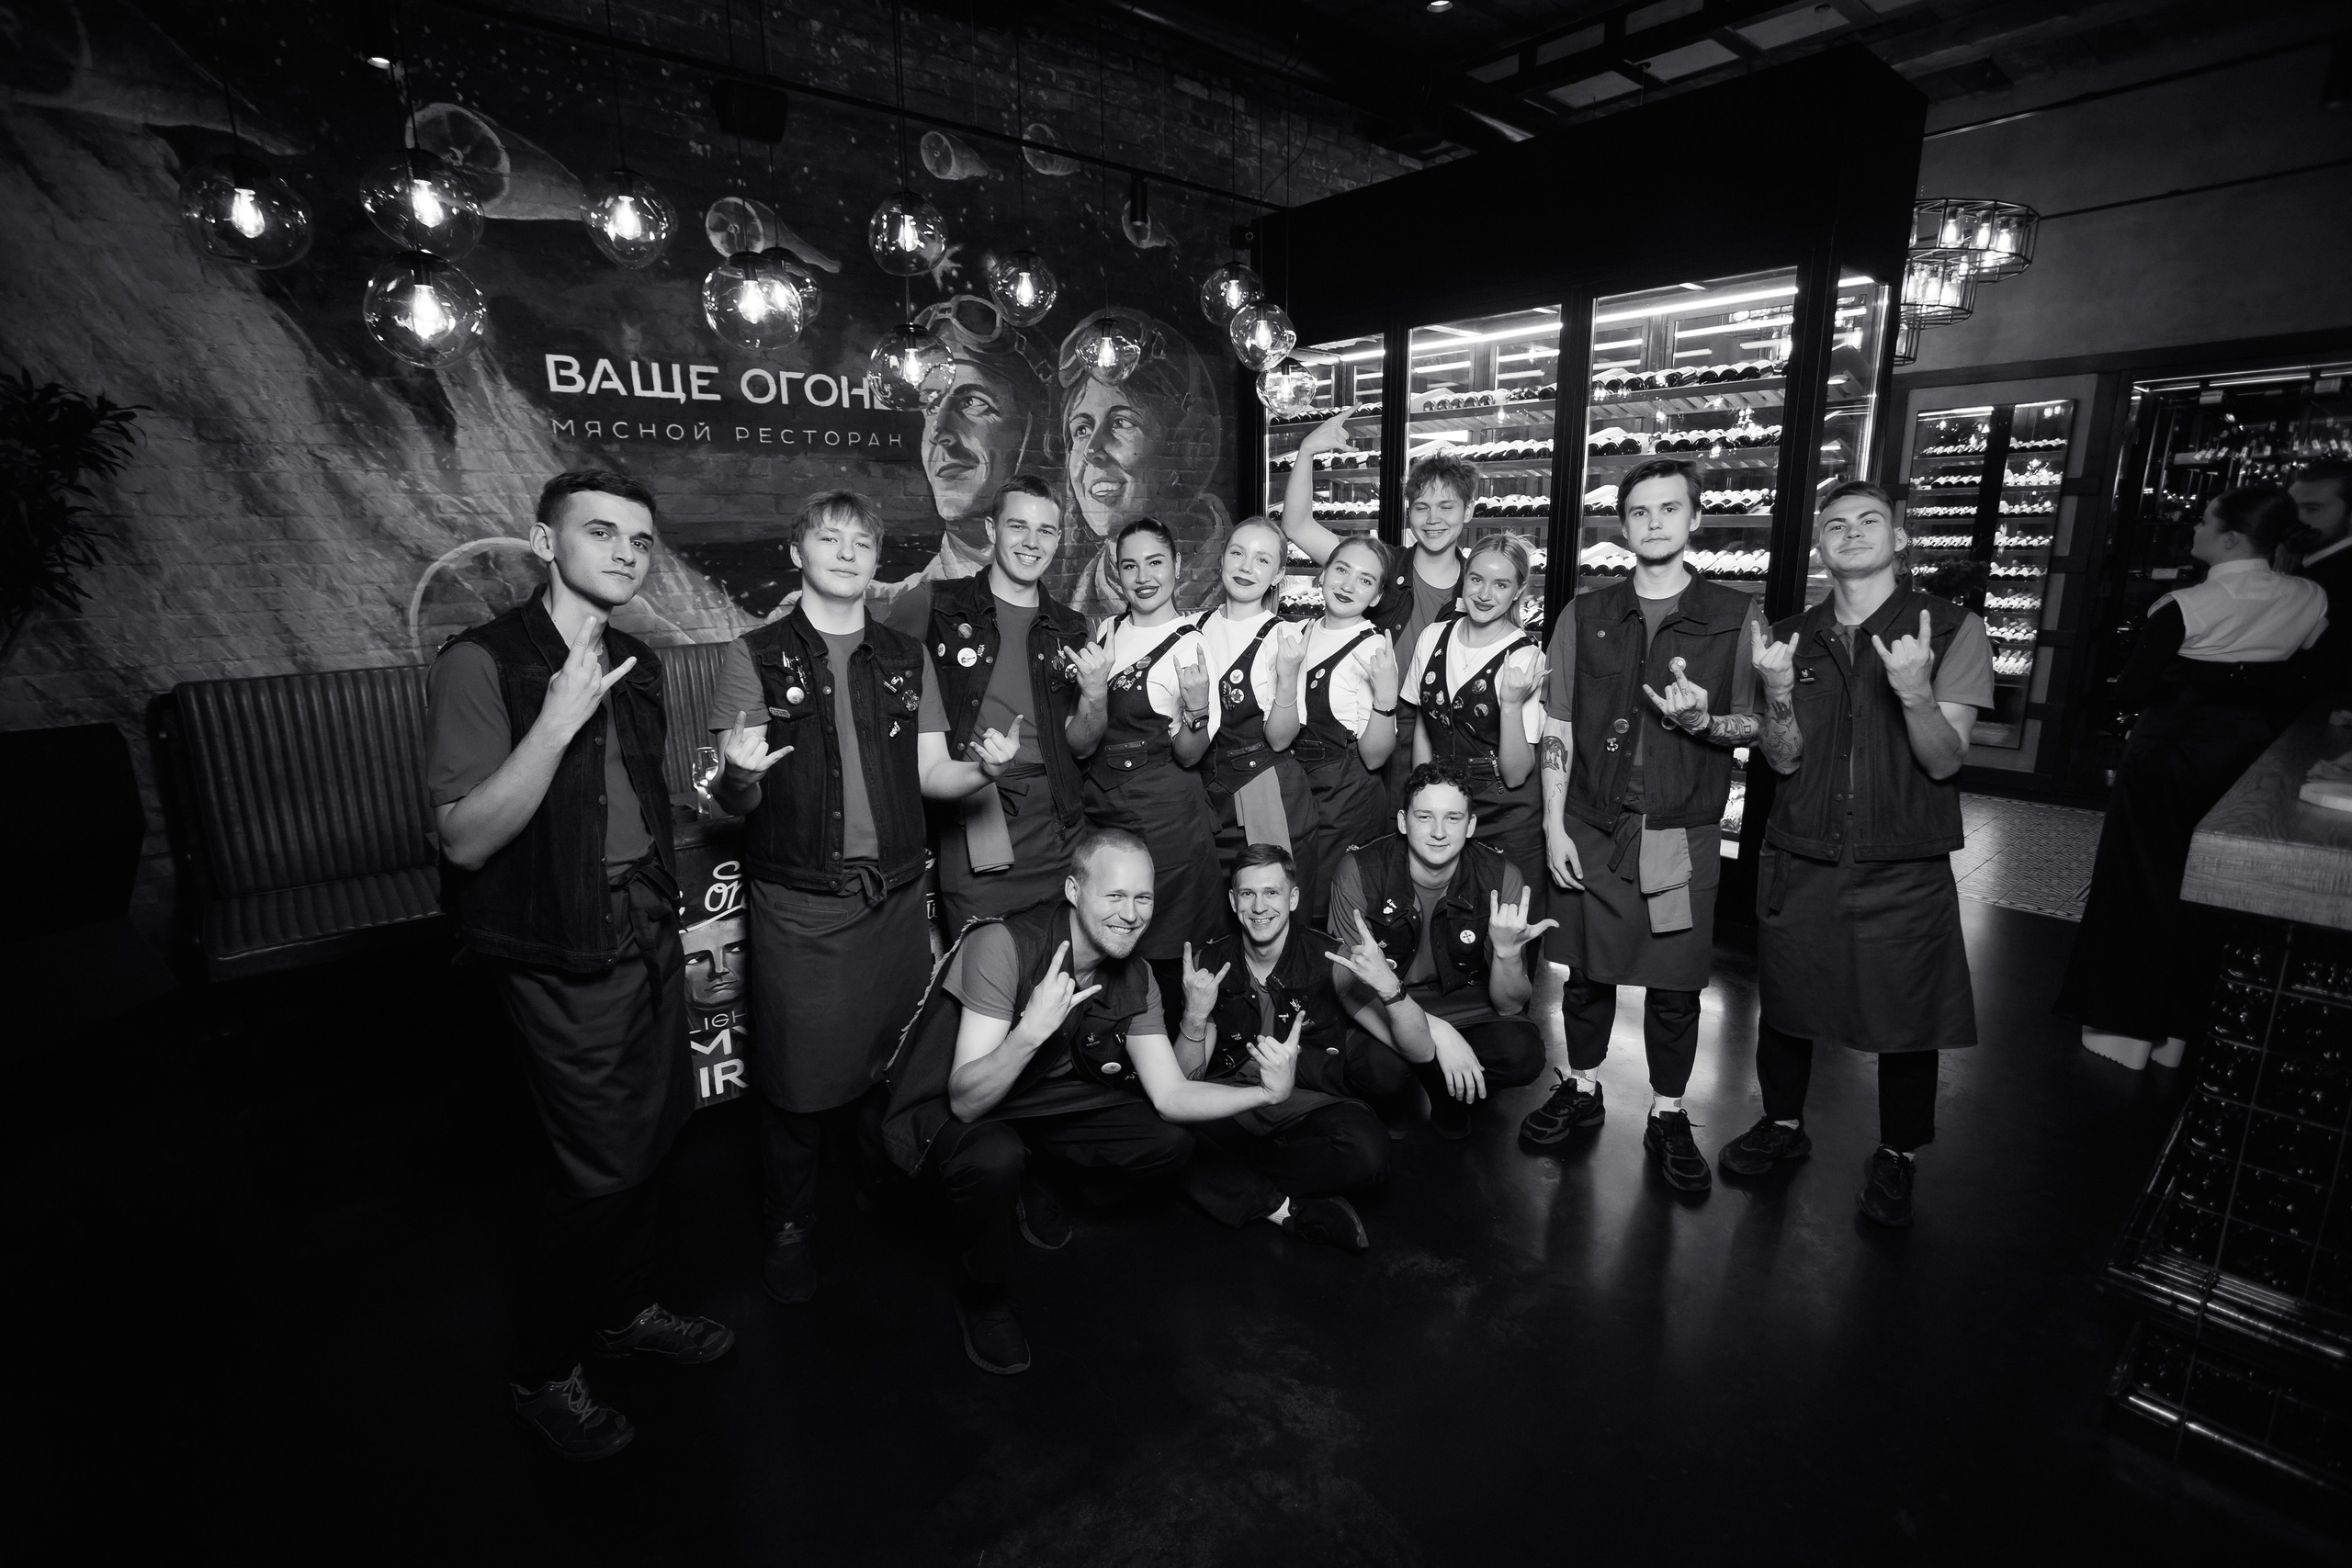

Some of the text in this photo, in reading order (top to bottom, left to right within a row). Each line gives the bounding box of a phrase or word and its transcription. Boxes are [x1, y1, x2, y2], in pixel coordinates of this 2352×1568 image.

[545, 354, 721, 405] ВАЩЕ
[551, 419, 902, 448] МЯСНОЙ РЕСТОРАН
